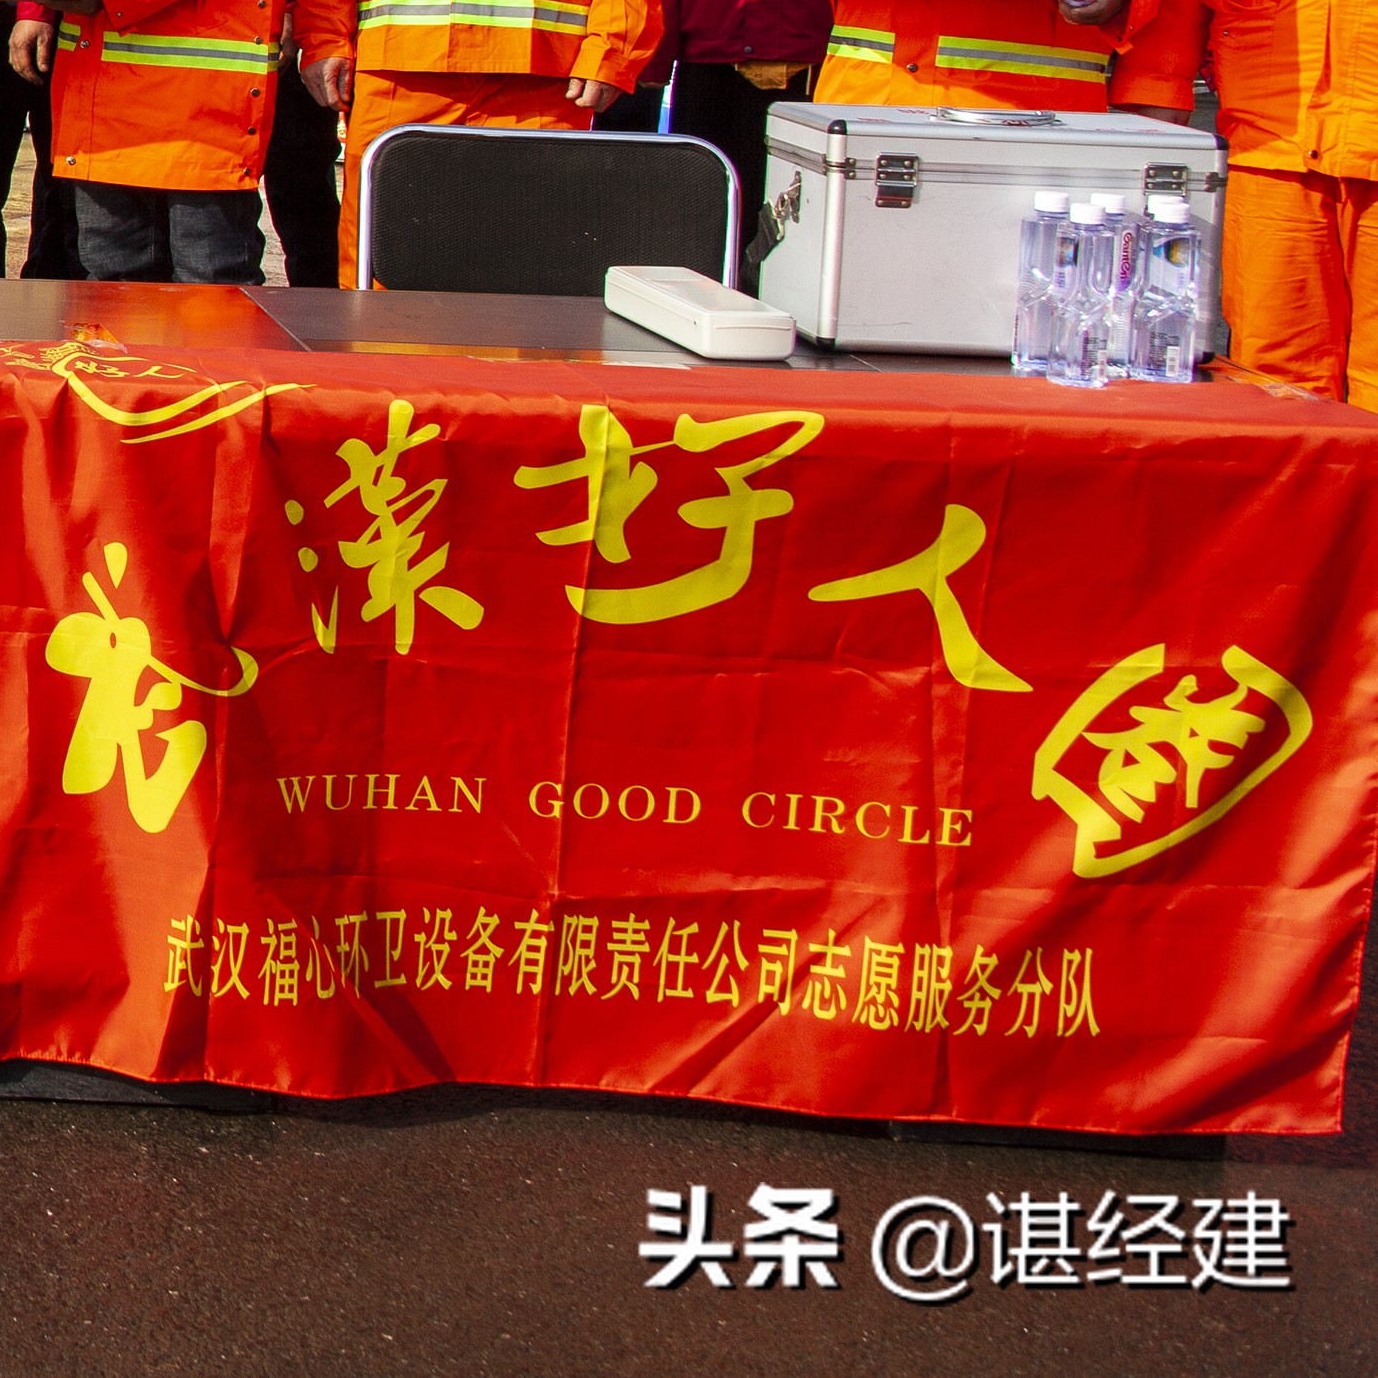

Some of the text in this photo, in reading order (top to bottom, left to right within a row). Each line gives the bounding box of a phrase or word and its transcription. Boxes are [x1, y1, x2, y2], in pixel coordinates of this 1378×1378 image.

[275, 773, 974, 849] WUHAN GOOD CIRCLE
[164, 909, 1102, 1041] 武汉福心环卫设备有限责任公司志愿服务分队
